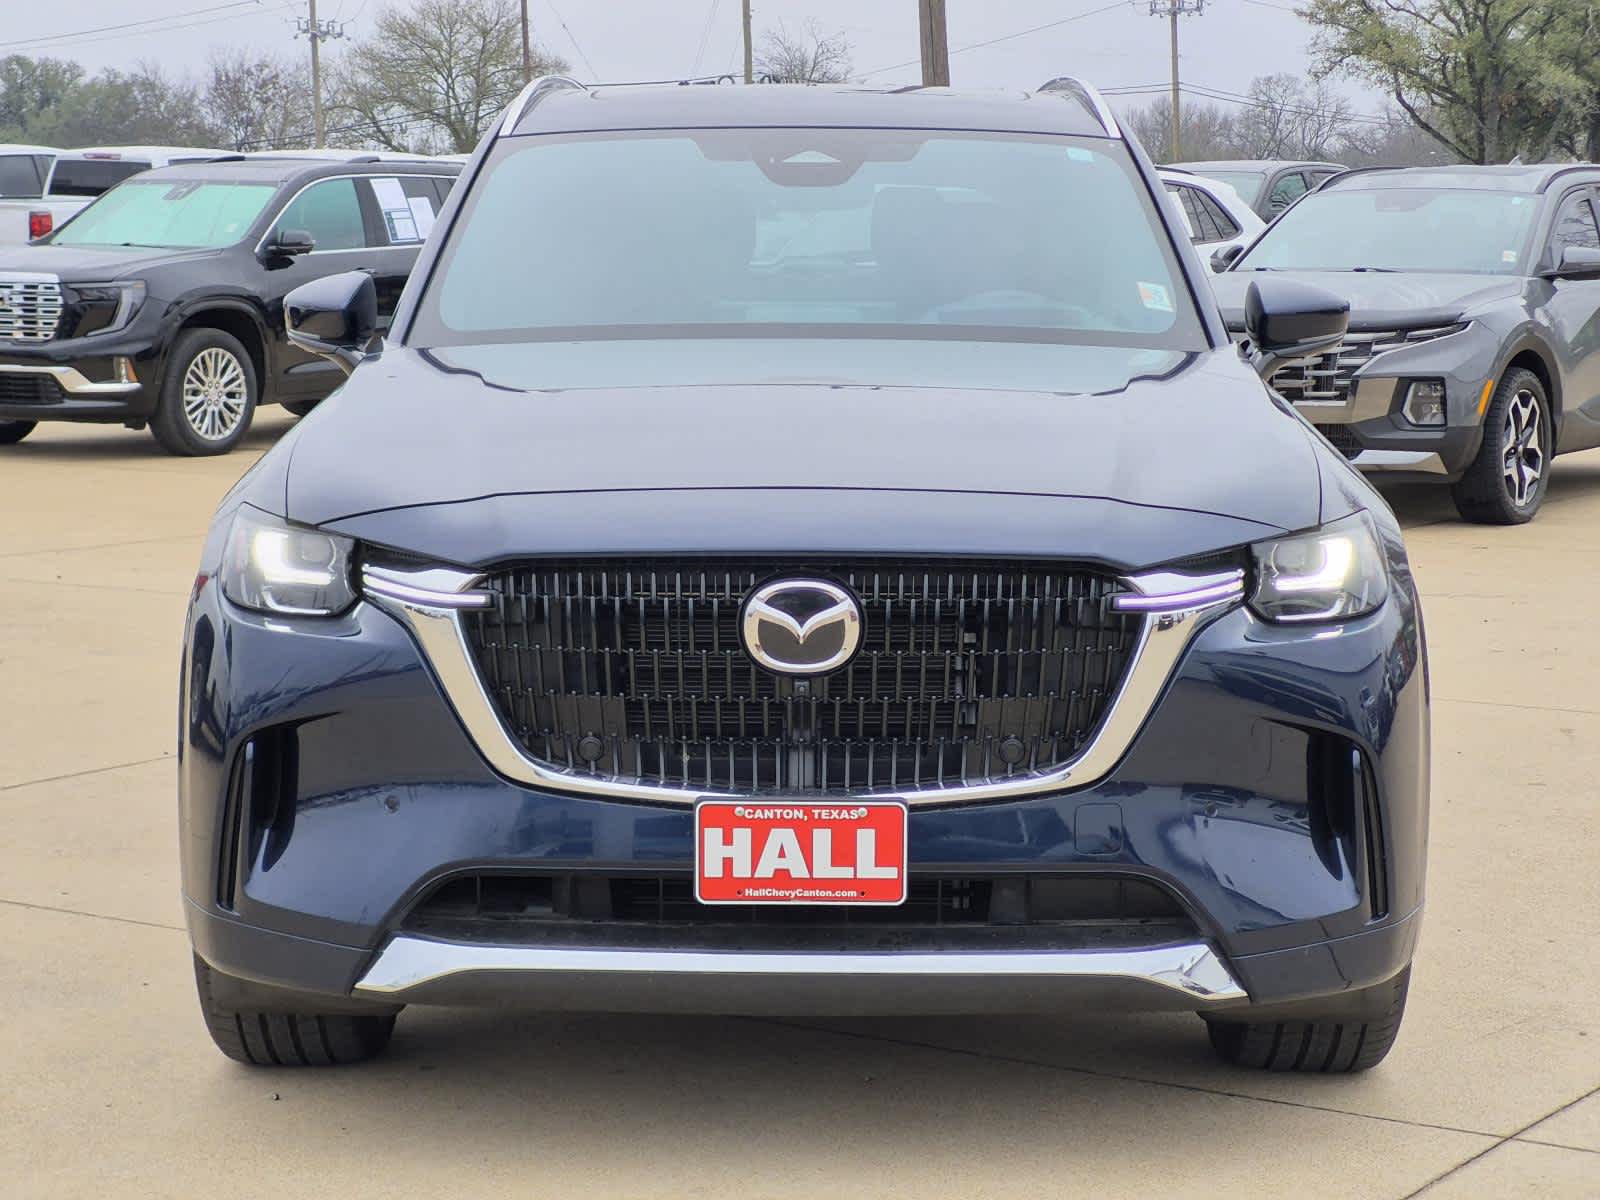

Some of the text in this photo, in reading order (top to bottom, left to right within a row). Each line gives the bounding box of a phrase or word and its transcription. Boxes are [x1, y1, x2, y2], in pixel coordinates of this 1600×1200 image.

[744, 808, 858, 821] CANTON, TEXAS
[704, 828, 898, 878] HALL
[745, 888, 857, 898] HallChevyCanton.com
